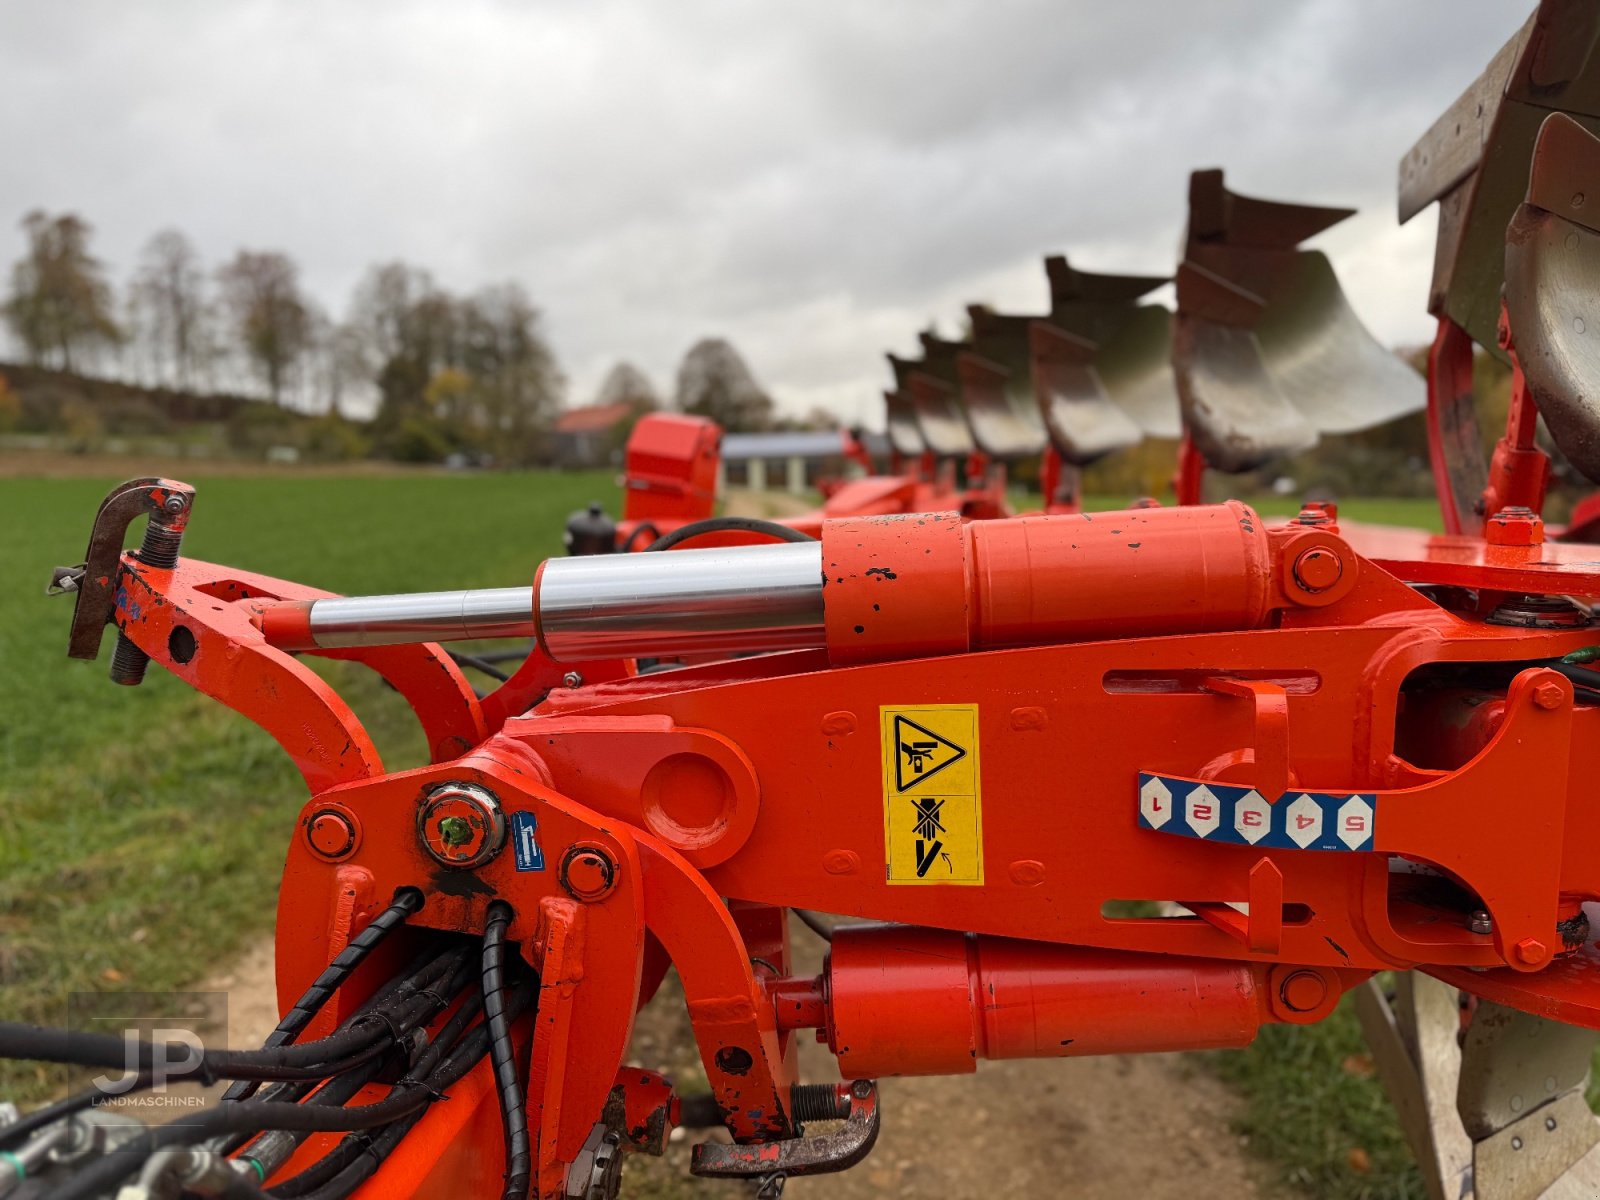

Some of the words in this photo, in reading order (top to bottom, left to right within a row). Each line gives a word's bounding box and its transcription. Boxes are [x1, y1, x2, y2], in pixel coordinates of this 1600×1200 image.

[1153, 797, 1162, 811] 1
[1193, 804, 1212, 819] 2
[1242, 810, 1262, 825] 3
[1296, 814, 1315, 829] 4
[1345, 816, 1365, 831] 5
